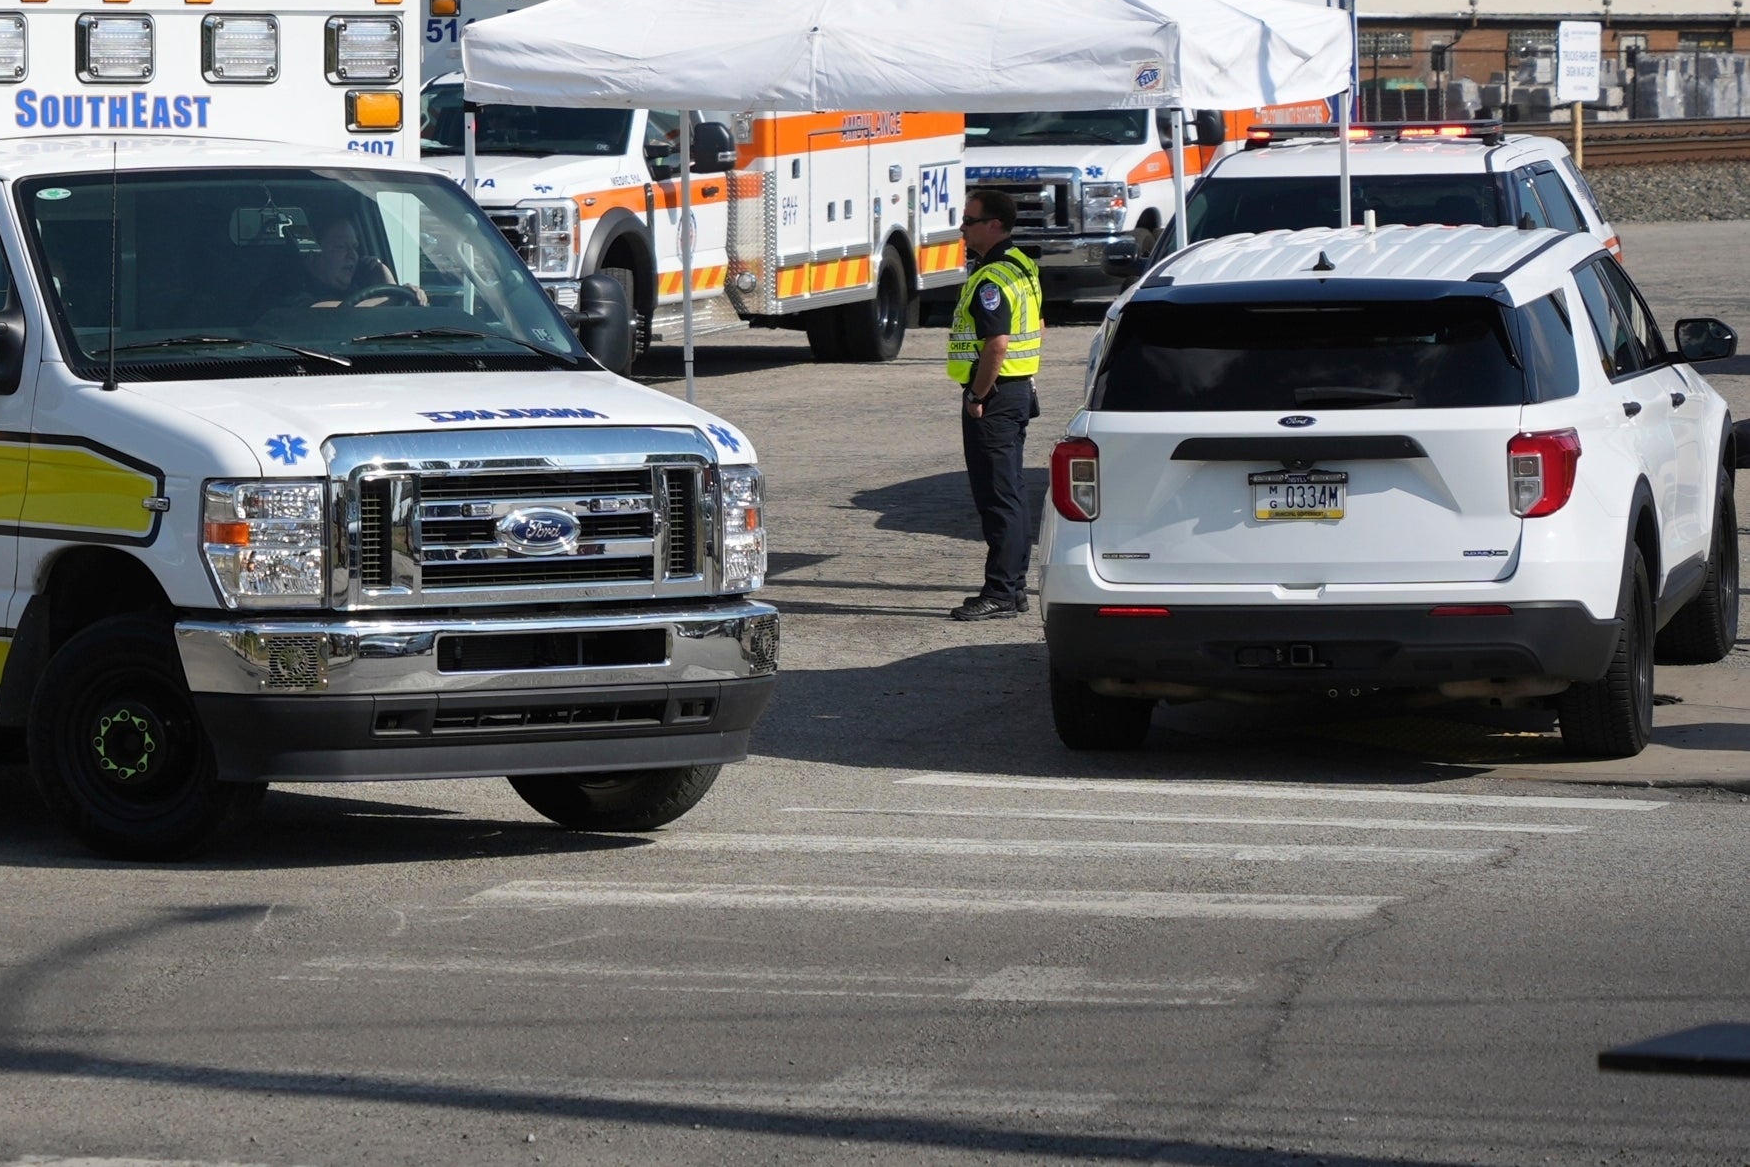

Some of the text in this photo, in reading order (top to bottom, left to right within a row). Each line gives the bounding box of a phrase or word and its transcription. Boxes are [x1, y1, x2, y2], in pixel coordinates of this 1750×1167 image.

[426, 18, 476, 43] 51
[15, 88, 211, 129] SOUTHEAST
[840, 112, 902, 143] AMBULANCE
[610, 176, 630, 186] MEDIC
[921, 167, 949, 214] 514
[782, 196, 798, 209] CALL
[782, 211, 798, 226] 911
[950, 341, 971, 351] CHIEF
[1285, 417, 1309, 425] Ford
[1269, 485, 1279, 495] M
[1286, 485, 1339, 509] 0334M
[1269, 499, 1279, 510] G
[525, 519, 563, 538] Ford
